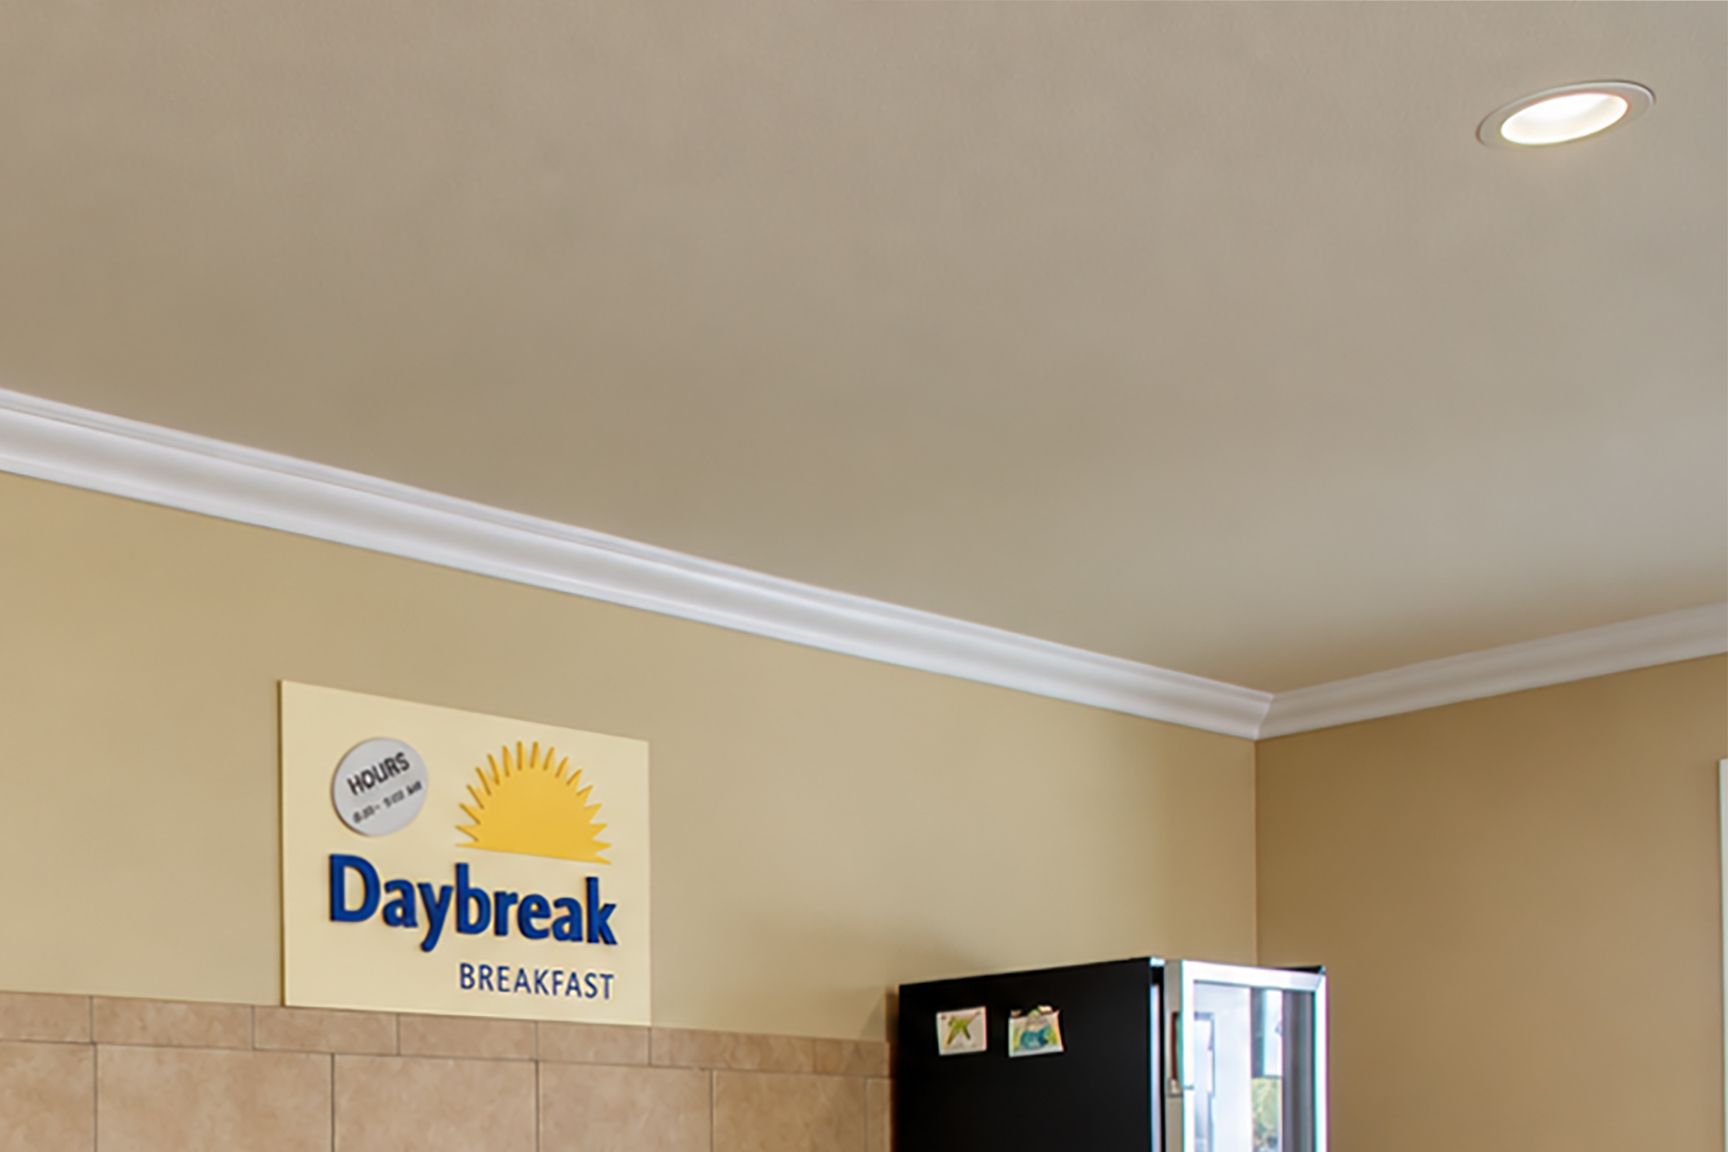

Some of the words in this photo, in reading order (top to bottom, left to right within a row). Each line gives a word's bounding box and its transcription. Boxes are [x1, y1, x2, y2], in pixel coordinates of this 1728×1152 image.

[347, 751, 410, 796] HOURS
[328, 853, 619, 953] Daybreak
[458, 961, 615, 1001] BREAKFAST
